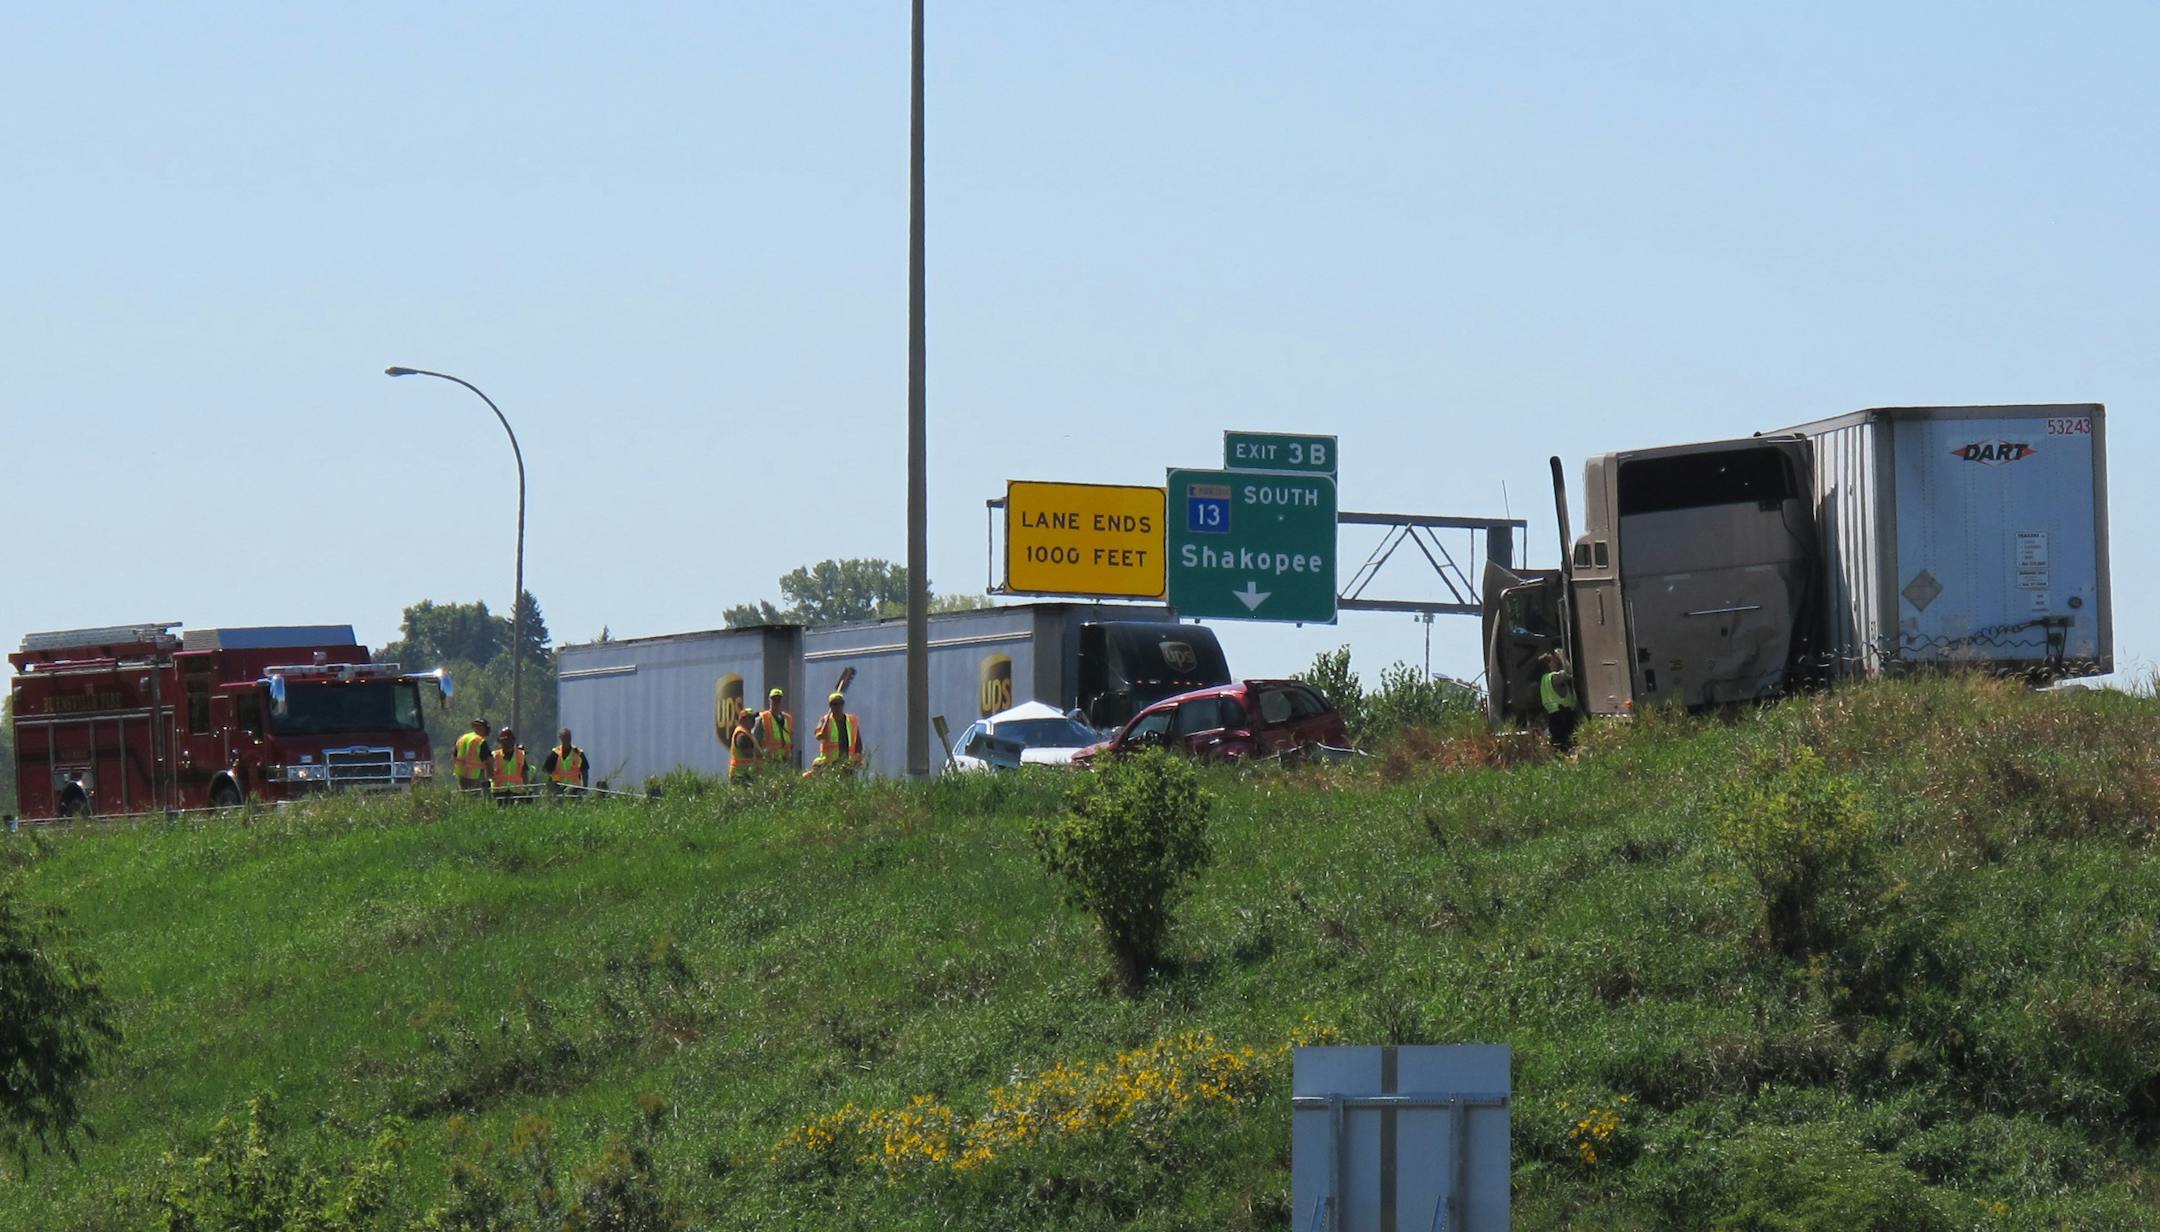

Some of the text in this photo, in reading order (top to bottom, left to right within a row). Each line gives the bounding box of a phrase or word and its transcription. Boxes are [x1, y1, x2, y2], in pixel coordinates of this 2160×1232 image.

[2047, 419, 2091, 435] 53243
[1236, 443, 1326, 465] EXIT 3B
[1963, 443, 2029, 461] DART
[1244, 486, 1318, 506] SOUTH
[1022, 511, 1151, 533] LANE ENDS
[1198, 503, 1220, 526] 13
[1027, 545, 1147, 567] 1000 FEET
[1181, 543, 1322, 575] Shakopee
[982, 679, 1011, 713] ups
